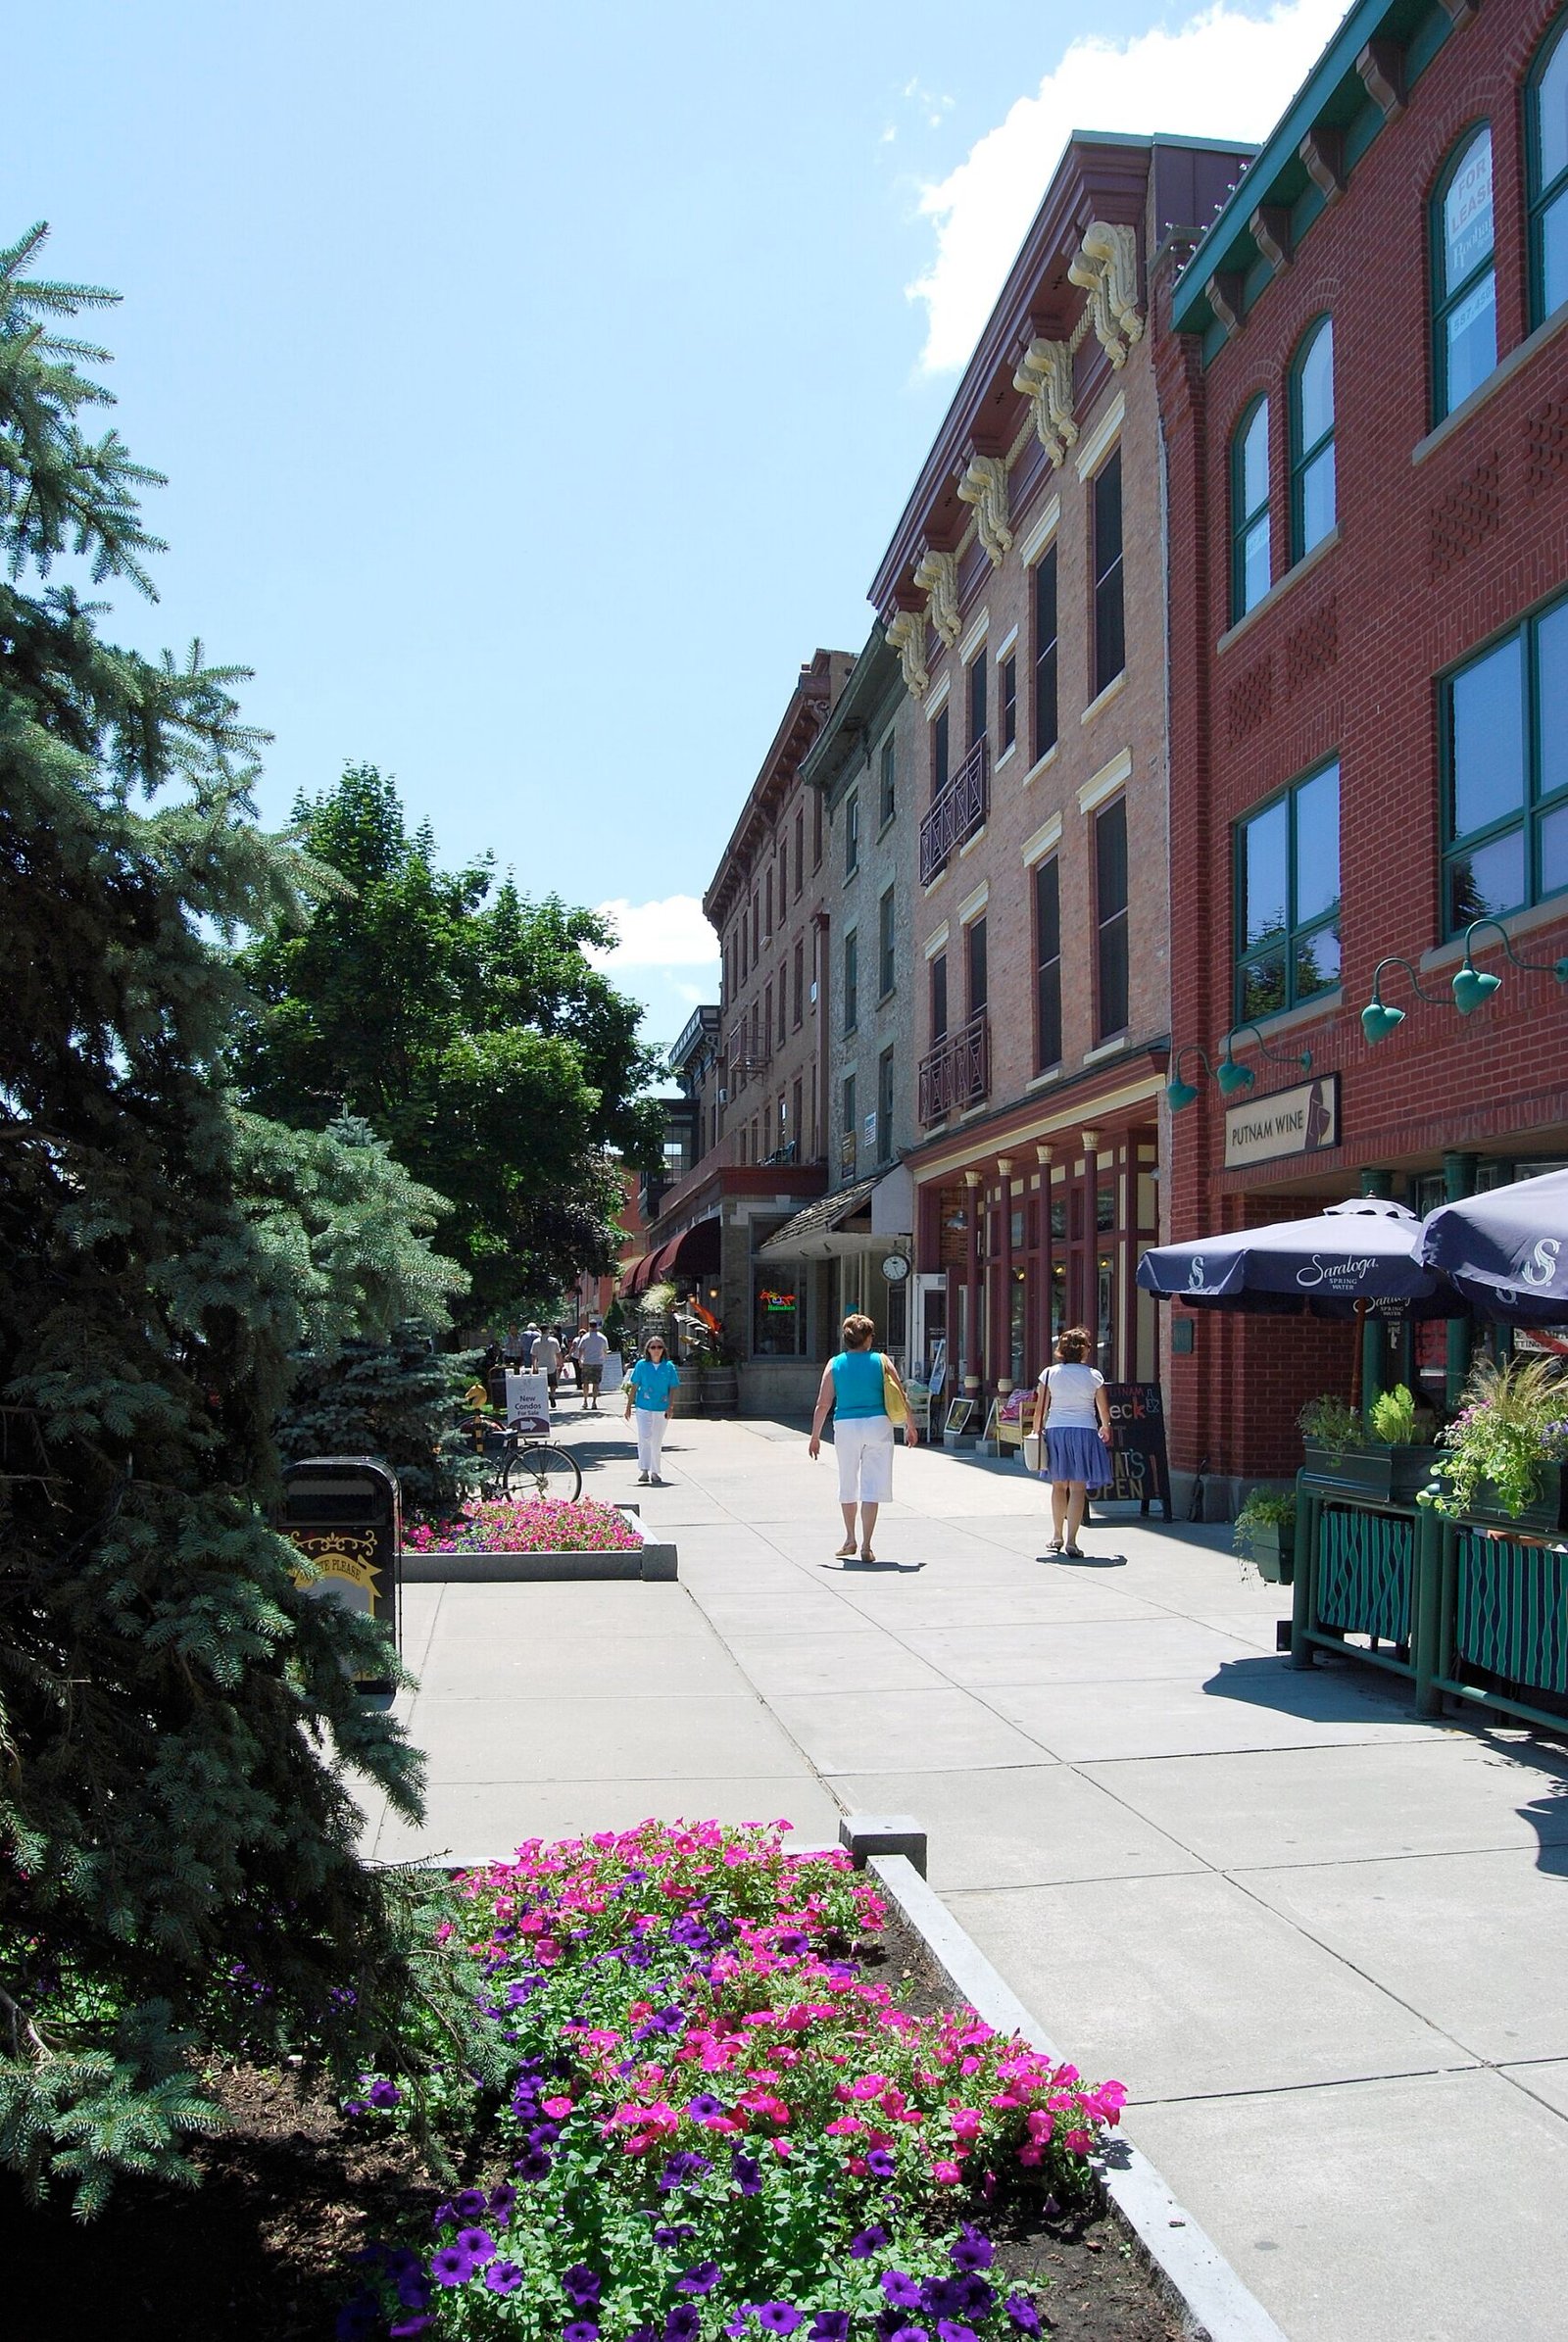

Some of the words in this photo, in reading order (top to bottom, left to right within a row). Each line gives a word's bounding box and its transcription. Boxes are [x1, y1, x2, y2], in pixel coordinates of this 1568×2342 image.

[1458, 158, 1487, 200] FOR
[1232, 1118, 1273, 1147] PUTNAM
[1275, 1110, 1304, 1134] WINE
[1296, 1254, 1377, 1287] Saratoga
[331, 1559, 362, 1582] PLEASE
